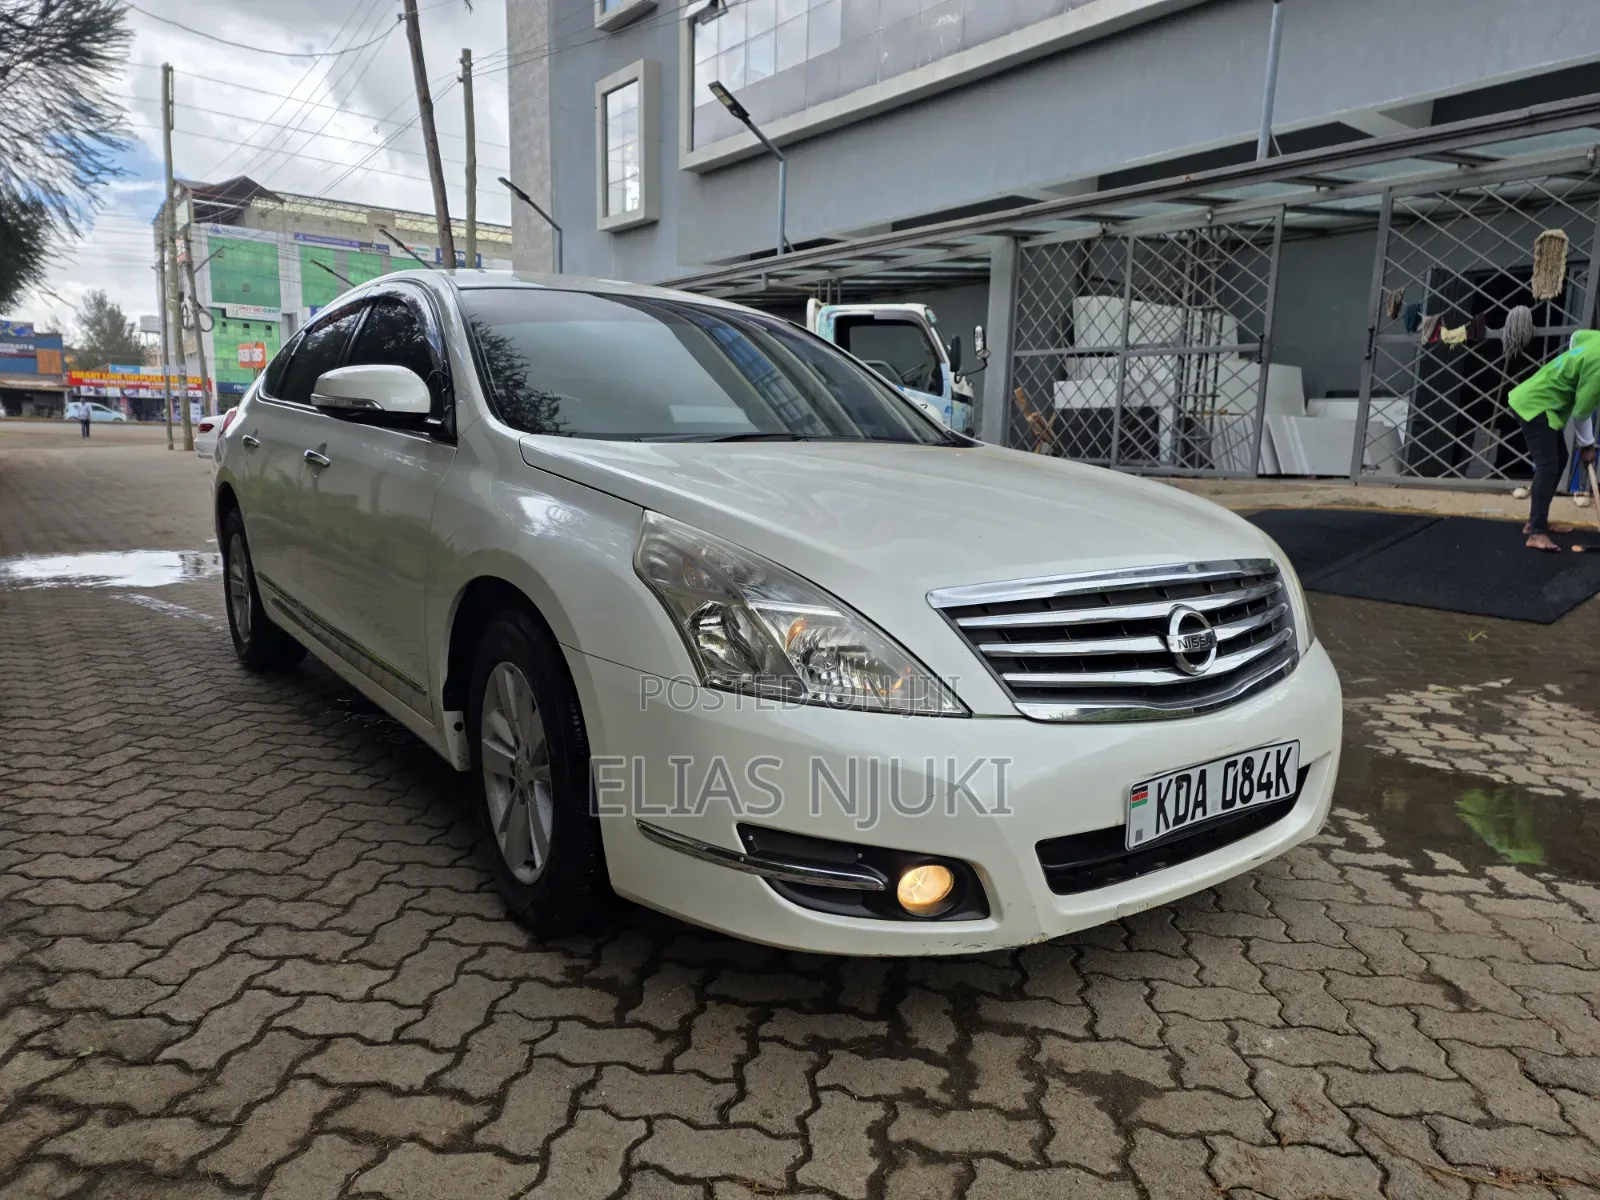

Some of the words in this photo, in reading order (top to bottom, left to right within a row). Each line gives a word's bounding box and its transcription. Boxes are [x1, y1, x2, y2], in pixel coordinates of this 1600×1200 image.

[71, 370, 100, 379] SMART
[103, 371, 122, 380] LINK
[124, 373, 161, 383] SUPPLIES
[1155, 769, 1207, 834] KDA
[1220, 746, 1293, 810] 084K
